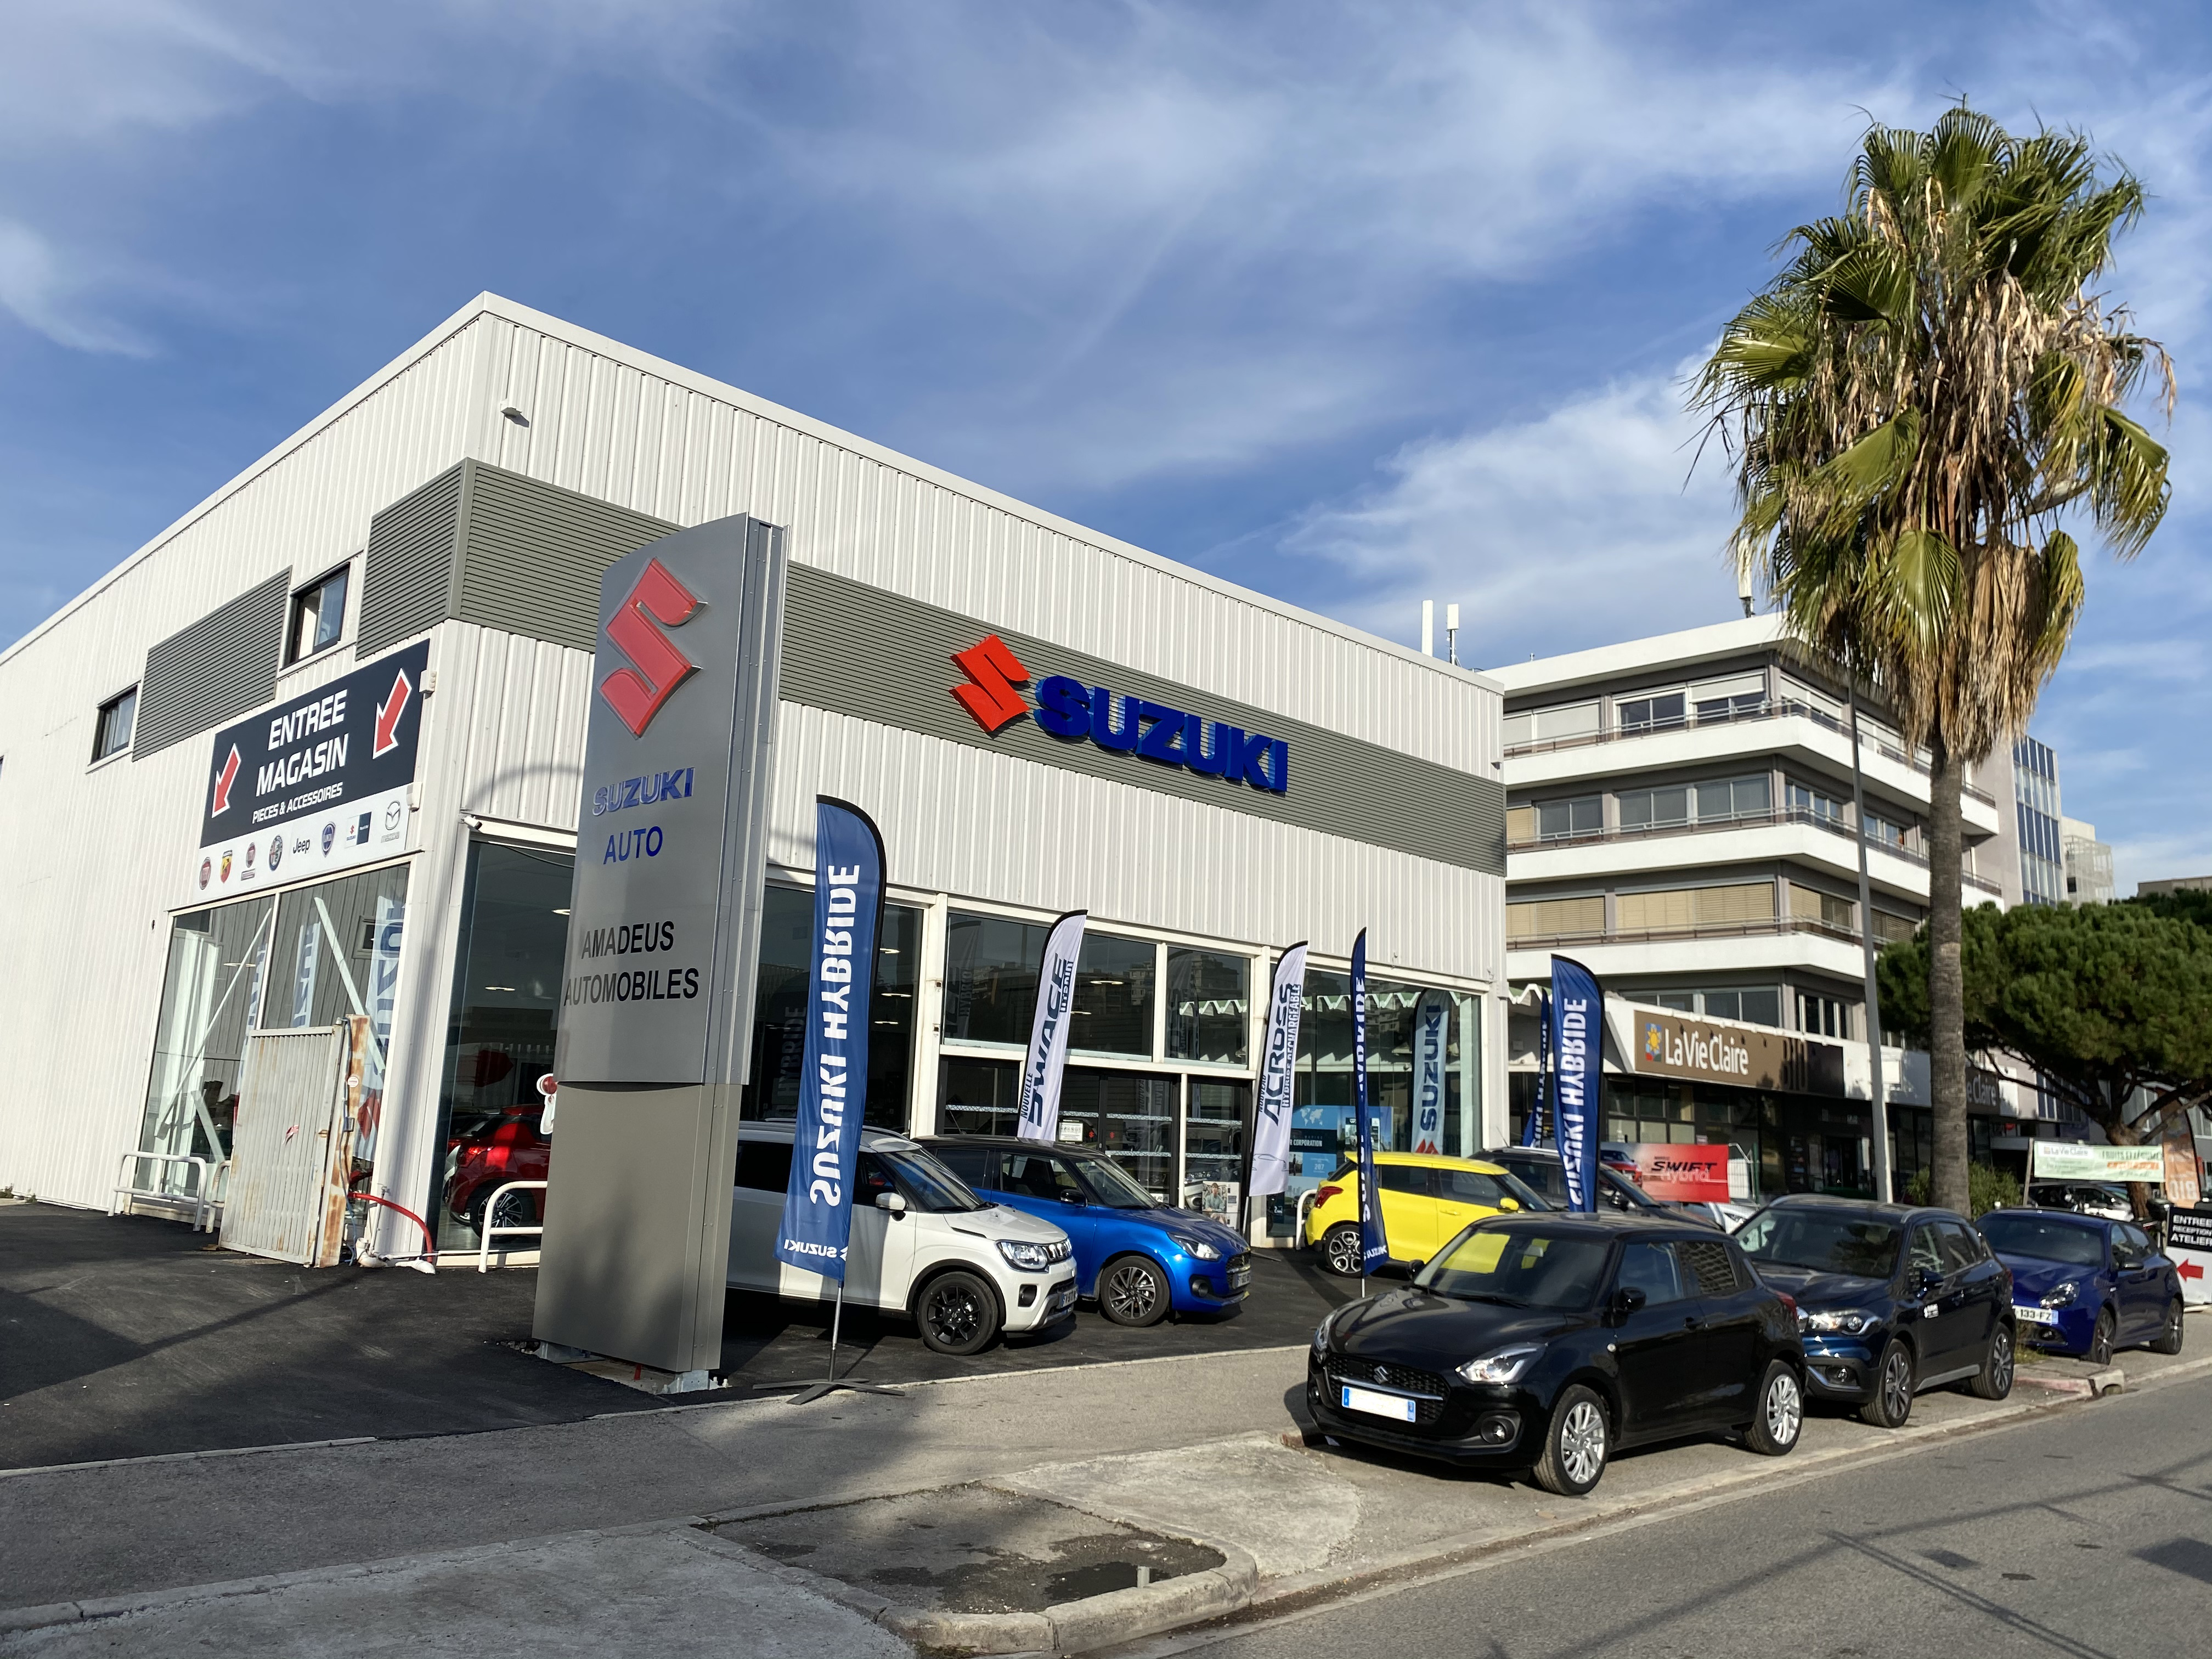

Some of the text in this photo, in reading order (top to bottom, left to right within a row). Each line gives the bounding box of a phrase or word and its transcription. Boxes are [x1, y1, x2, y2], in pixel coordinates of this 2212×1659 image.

[267, 689, 348, 751] ENTREE
[1034, 675, 1288, 793] SUZUKI
[256, 733, 349, 797] MAGASIN
[252, 782, 343, 824] PIECES & ACCESSOIRES
[592, 766, 695, 816] SUZUKI
[292, 838, 311, 854] Jeep
[603, 826, 663, 865] AUTO
[581, 920, 674, 960] AMADEUS
[563, 967, 699, 1007] AUTOMOBILES
[1263, 983, 1293, 1126] ACROSS
[1420, 1005, 1441, 1132] SUZUKI
[1020, 1071, 1034, 1119] NOUVELLE
[1293, 1139, 1323, 1147] CORPORATION
[1651, 1161, 1717, 1172] SWIFT
[1660, 1167, 1710, 1184] Hybrid
[2170, 1233, 2212, 1247] ATELIER
[2173, 1214, 2212, 1228] ENTREE
